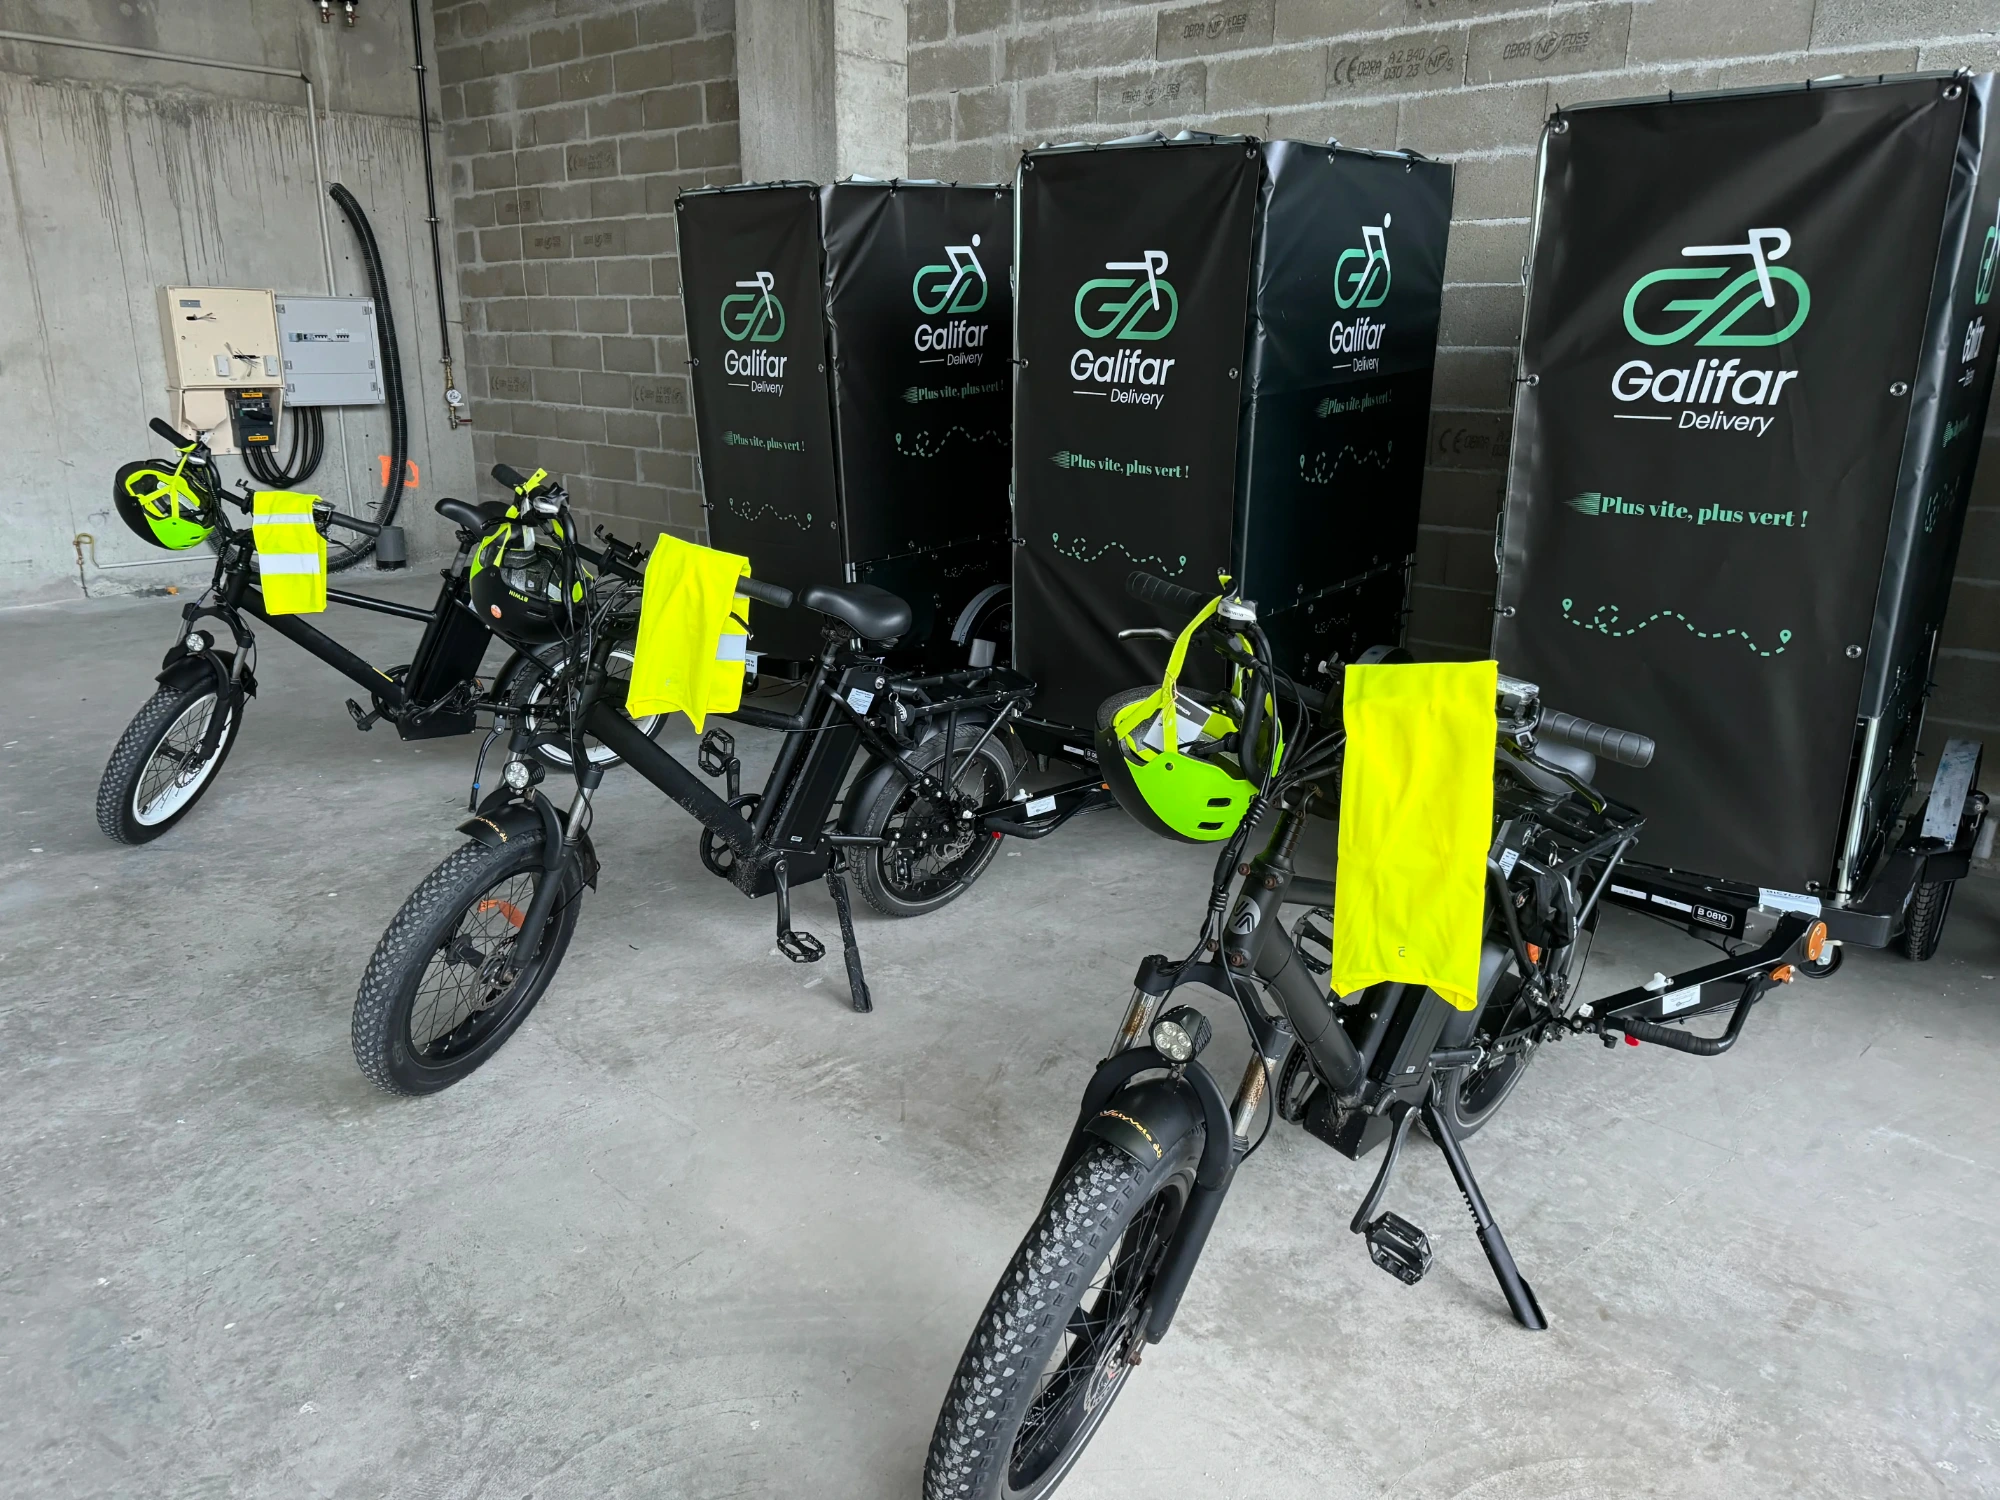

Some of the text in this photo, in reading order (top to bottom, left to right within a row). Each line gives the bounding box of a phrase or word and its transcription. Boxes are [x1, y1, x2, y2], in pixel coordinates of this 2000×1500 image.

[1503, 41, 1531, 60] OBRA
[914, 319, 989, 352] Galifar
[1329, 319, 1386, 355] Galifar
[724, 349, 788, 378] Galifar
[946, 352, 983, 367] Delivery
[1070, 348, 1175, 386] Galifar
[751, 380, 784, 397] Delivery
[918, 387, 939, 401] Plus
[940, 385, 960, 397] vite,
[961, 382, 980, 399] plus
[1611, 358, 1798, 406] Galifar
[1110, 388, 1165, 410] Delivery
[1327, 398, 1345, 415] Plus
[1678, 410, 1775, 438] Delivery
[733, 433, 749, 446] Plus
[749, 435, 766, 449] vite,
[766, 437, 783, 451] plus
[783, 441, 800, 452] vert
[1070, 453, 1096, 469] Plus
[1098, 457, 1124, 474] vite,
[1126, 459, 1153, 477] plus
[1154, 465, 1182, 478] vert
[1601, 496, 1645, 516] Plus
[1649, 500, 1693, 522] vite,
[1697, 503, 1744, 526] plus
[1748, 510, 1795, 527] vert
[1697, 907, 1728, 922] B 0810
